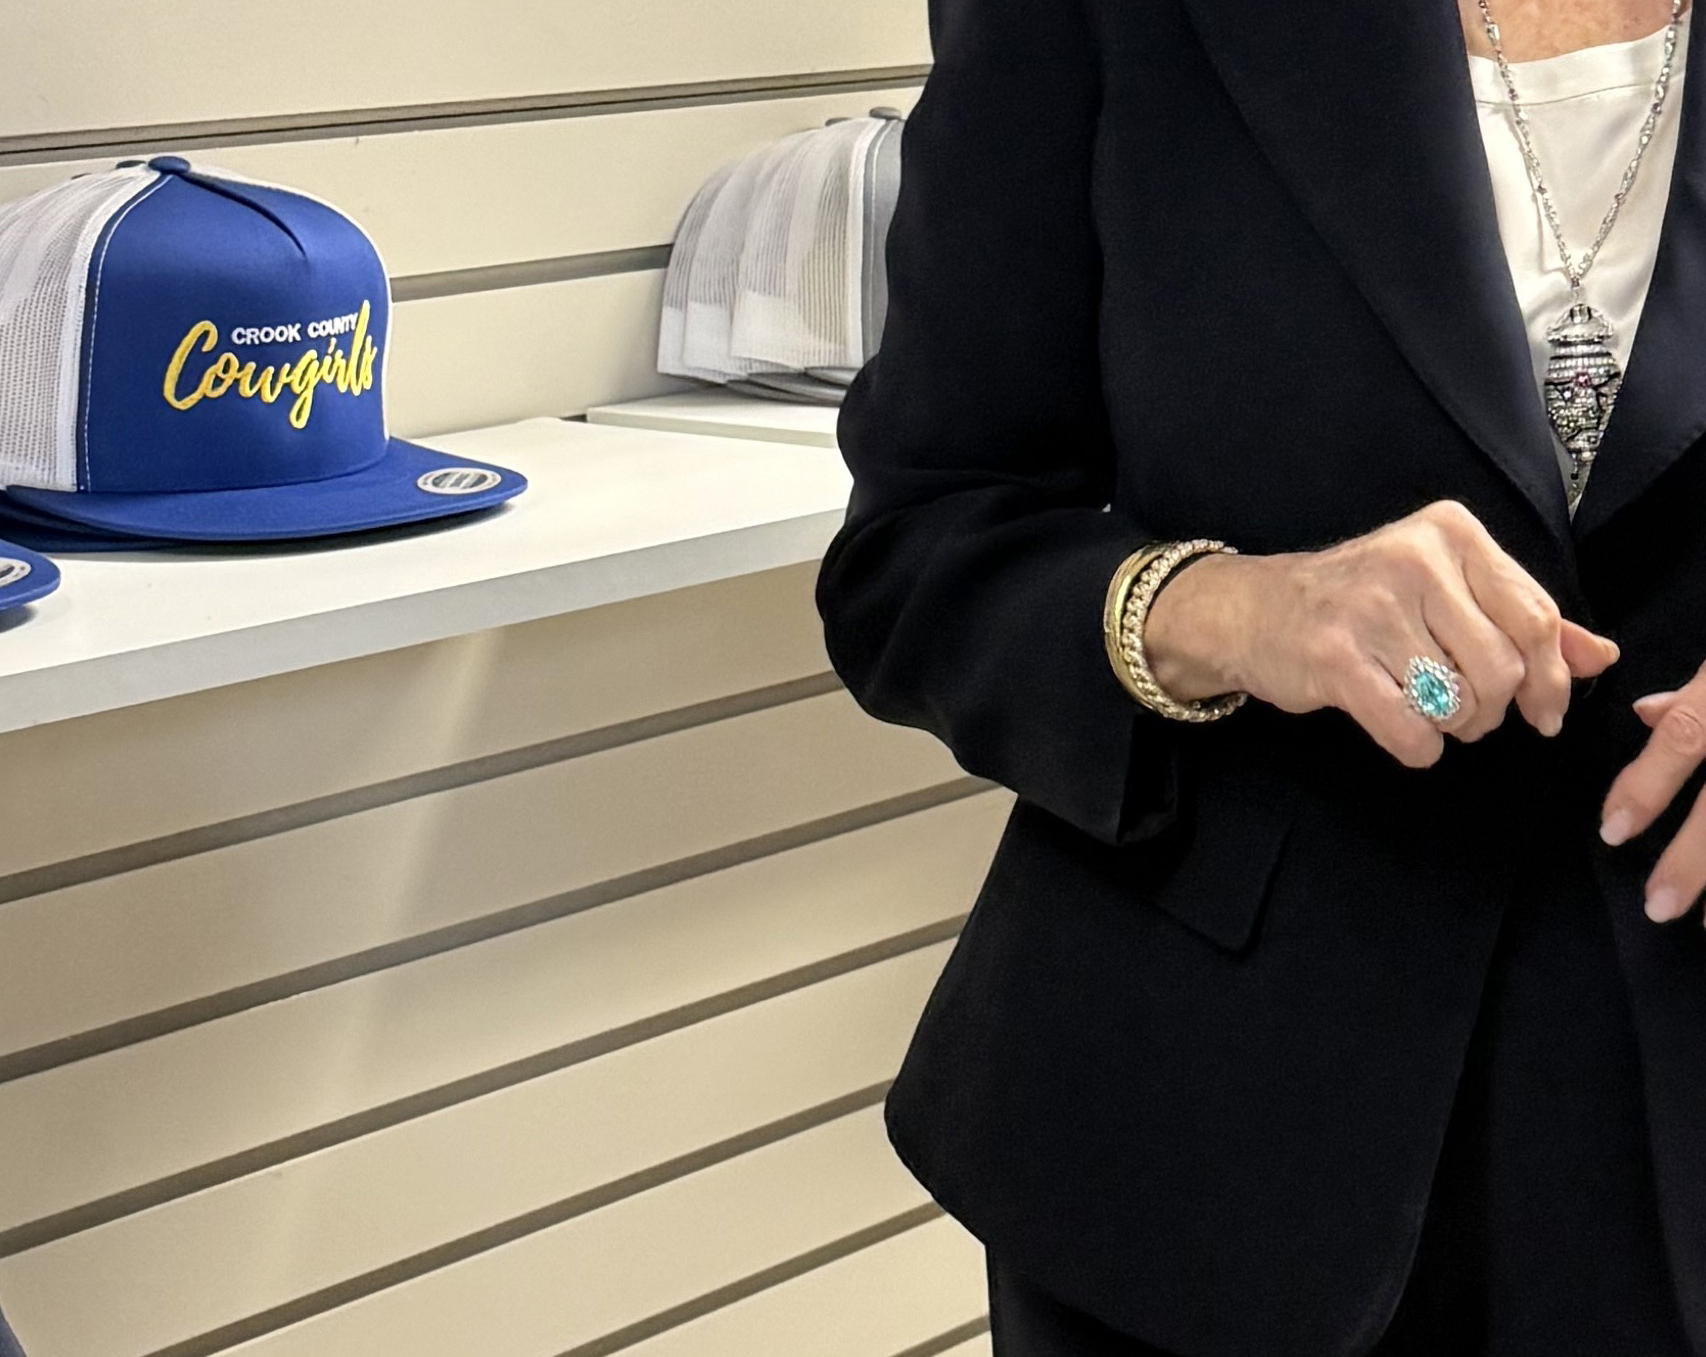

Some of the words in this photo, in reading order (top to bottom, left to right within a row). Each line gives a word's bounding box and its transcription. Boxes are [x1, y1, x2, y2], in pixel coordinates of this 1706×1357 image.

[163, 299, 378, 430] Cowgirls
[231, 323, 302, 346] CROOK
[307, 311, 360, 339] COUNTY
